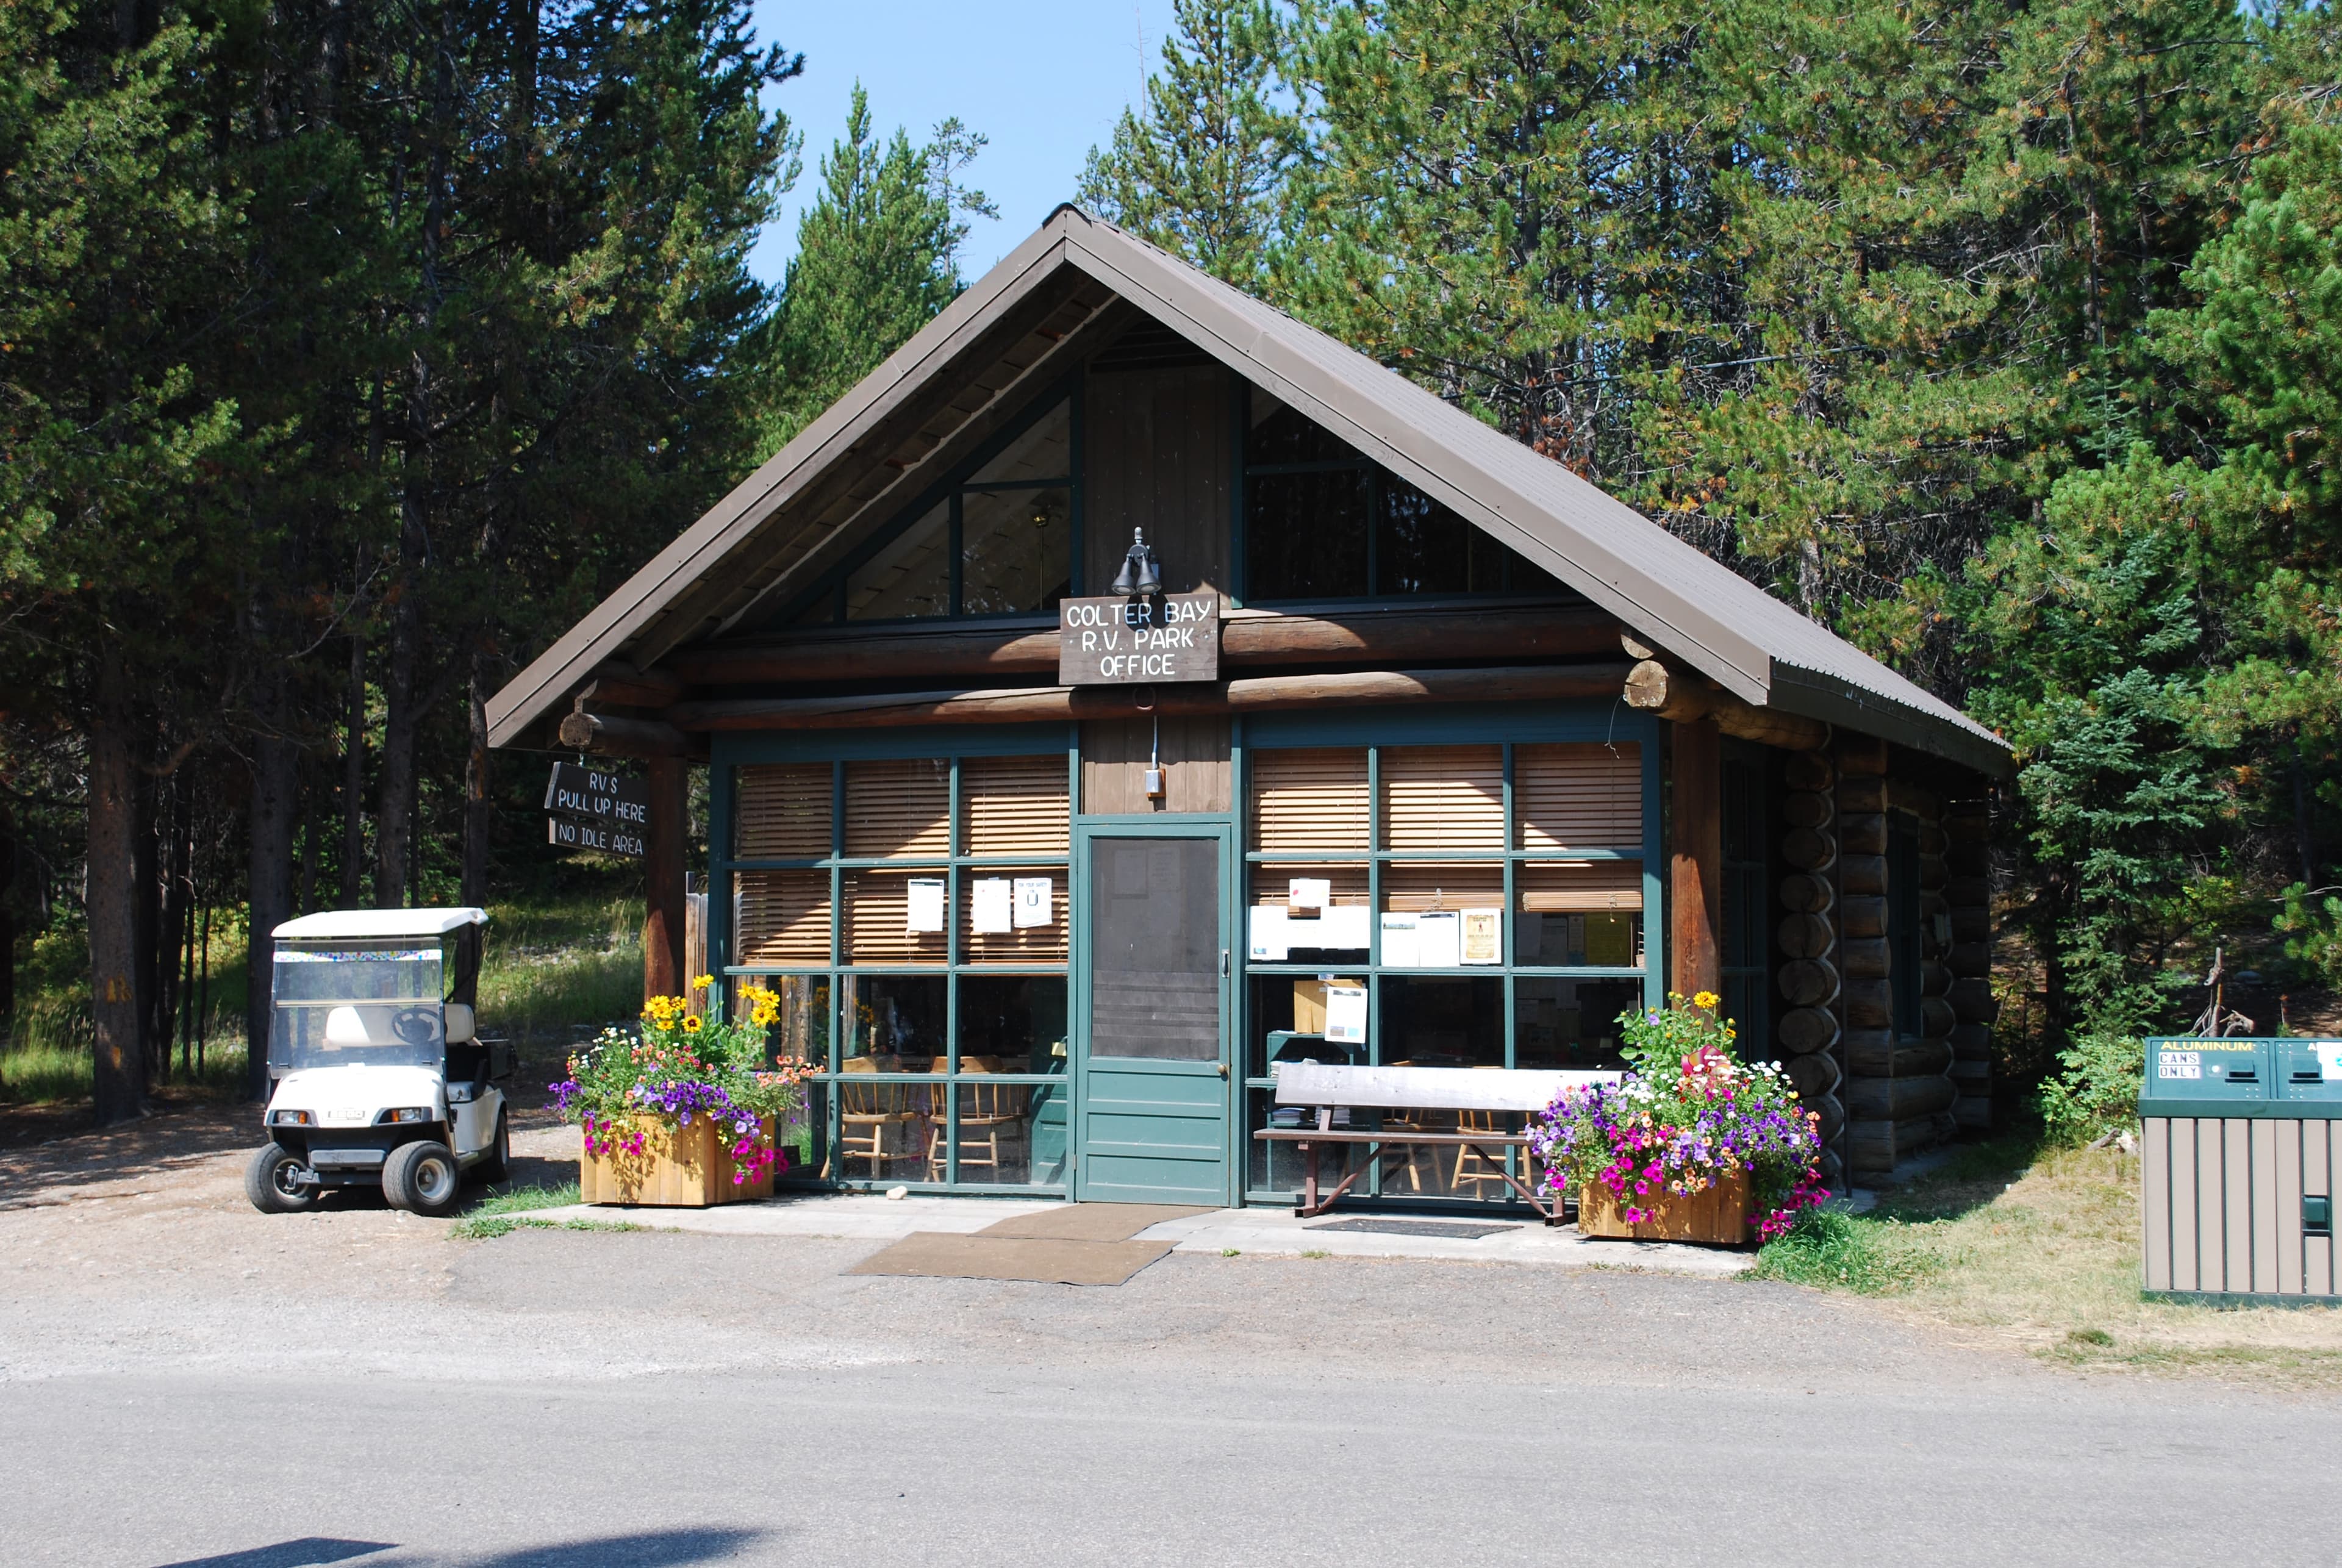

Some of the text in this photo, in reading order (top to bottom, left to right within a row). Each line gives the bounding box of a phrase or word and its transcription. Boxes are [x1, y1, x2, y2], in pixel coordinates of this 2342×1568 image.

[1067, 601, 1211, 628] COLTER BAY
[1082, 628, 1194, 652] R.V. PARK
[1100, 653, 1175, 677] OFFICE
[558, 789, 645, 823] PULL UP HERE
[559, 823, 643, 855] NO IDLE AREA
[2160, 1041, 2253, 1051] ALUMINUM
[2160, 1053, 2197, 1064] CANS
[2160, 1067, 2196, 1078] ONLY
